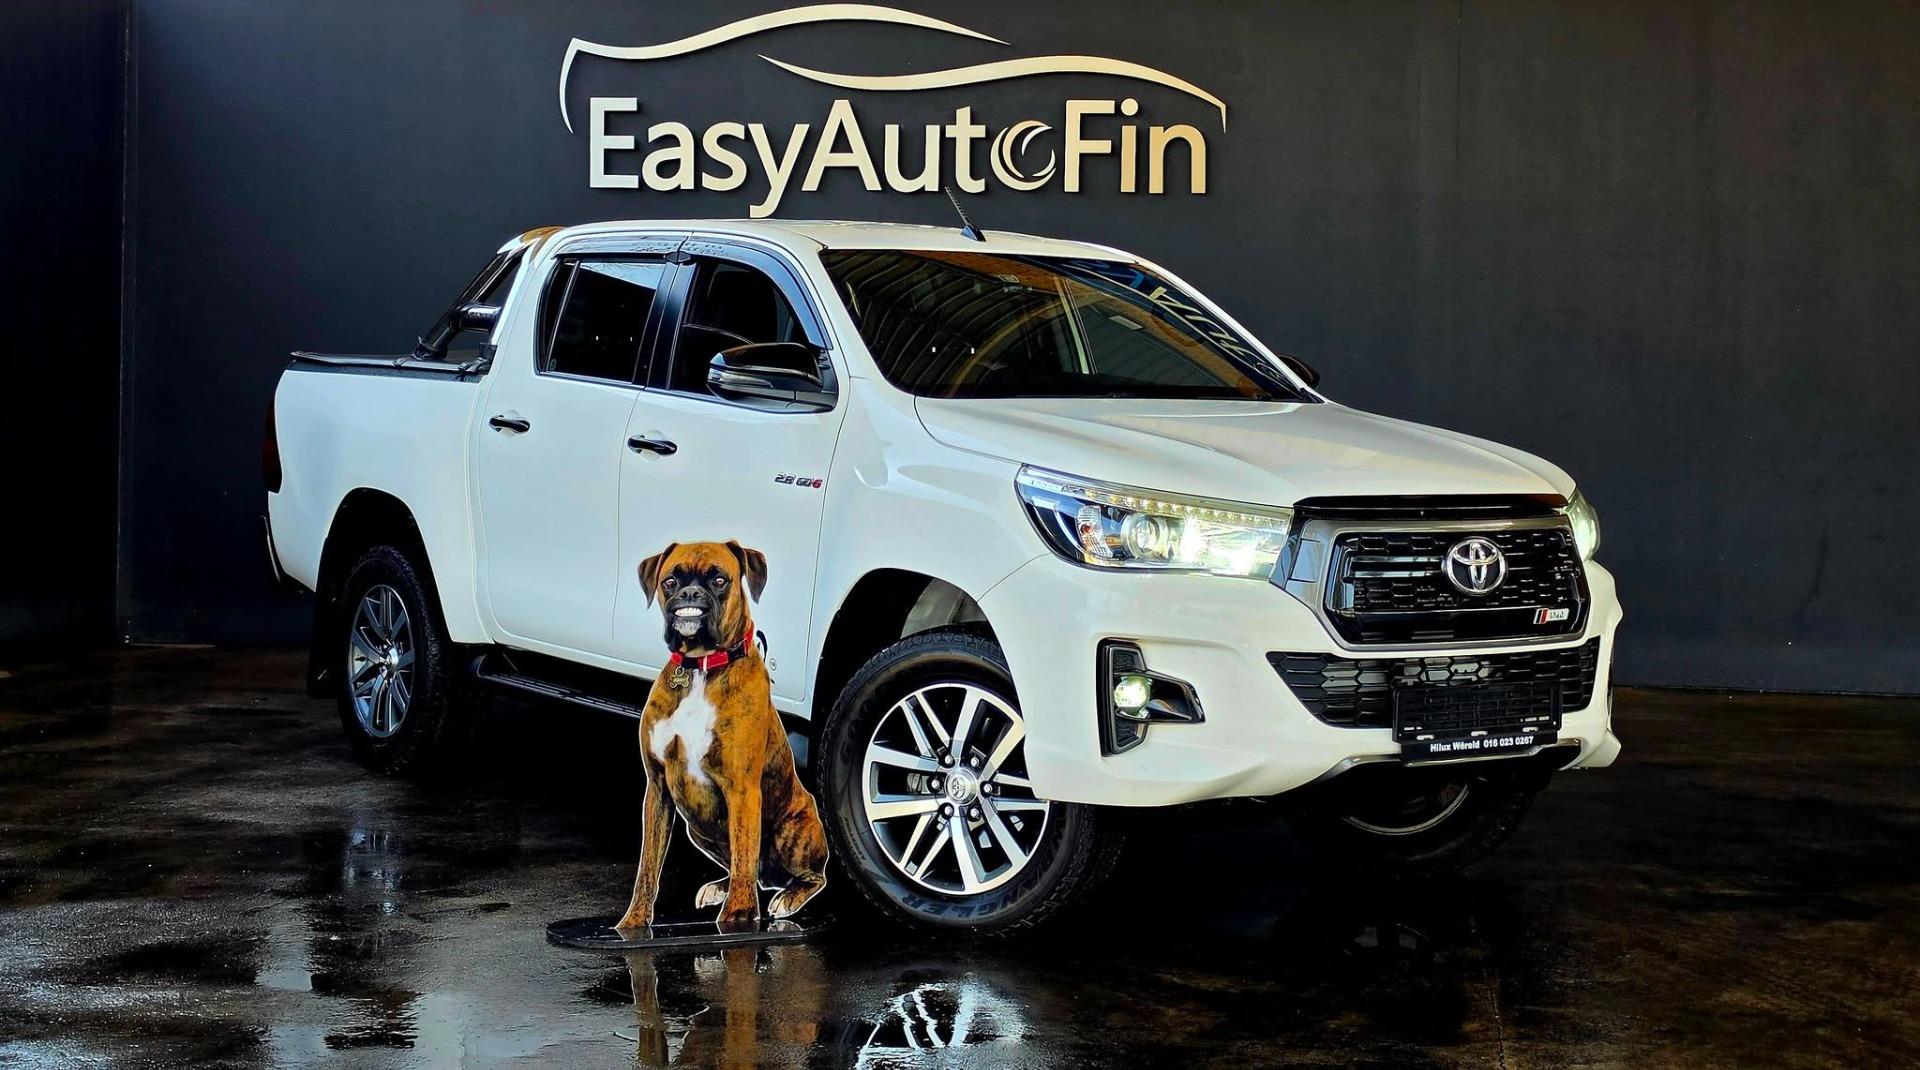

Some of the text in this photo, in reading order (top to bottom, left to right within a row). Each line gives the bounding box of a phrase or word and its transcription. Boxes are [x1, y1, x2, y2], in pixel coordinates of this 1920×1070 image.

[589, 97, 1208, 218] EasyAutoFin
[1430, 743, 1451, 752] Hilux
[1483, 739, 1498, 748] 016
[1499, 738, 1514, 747] 023
